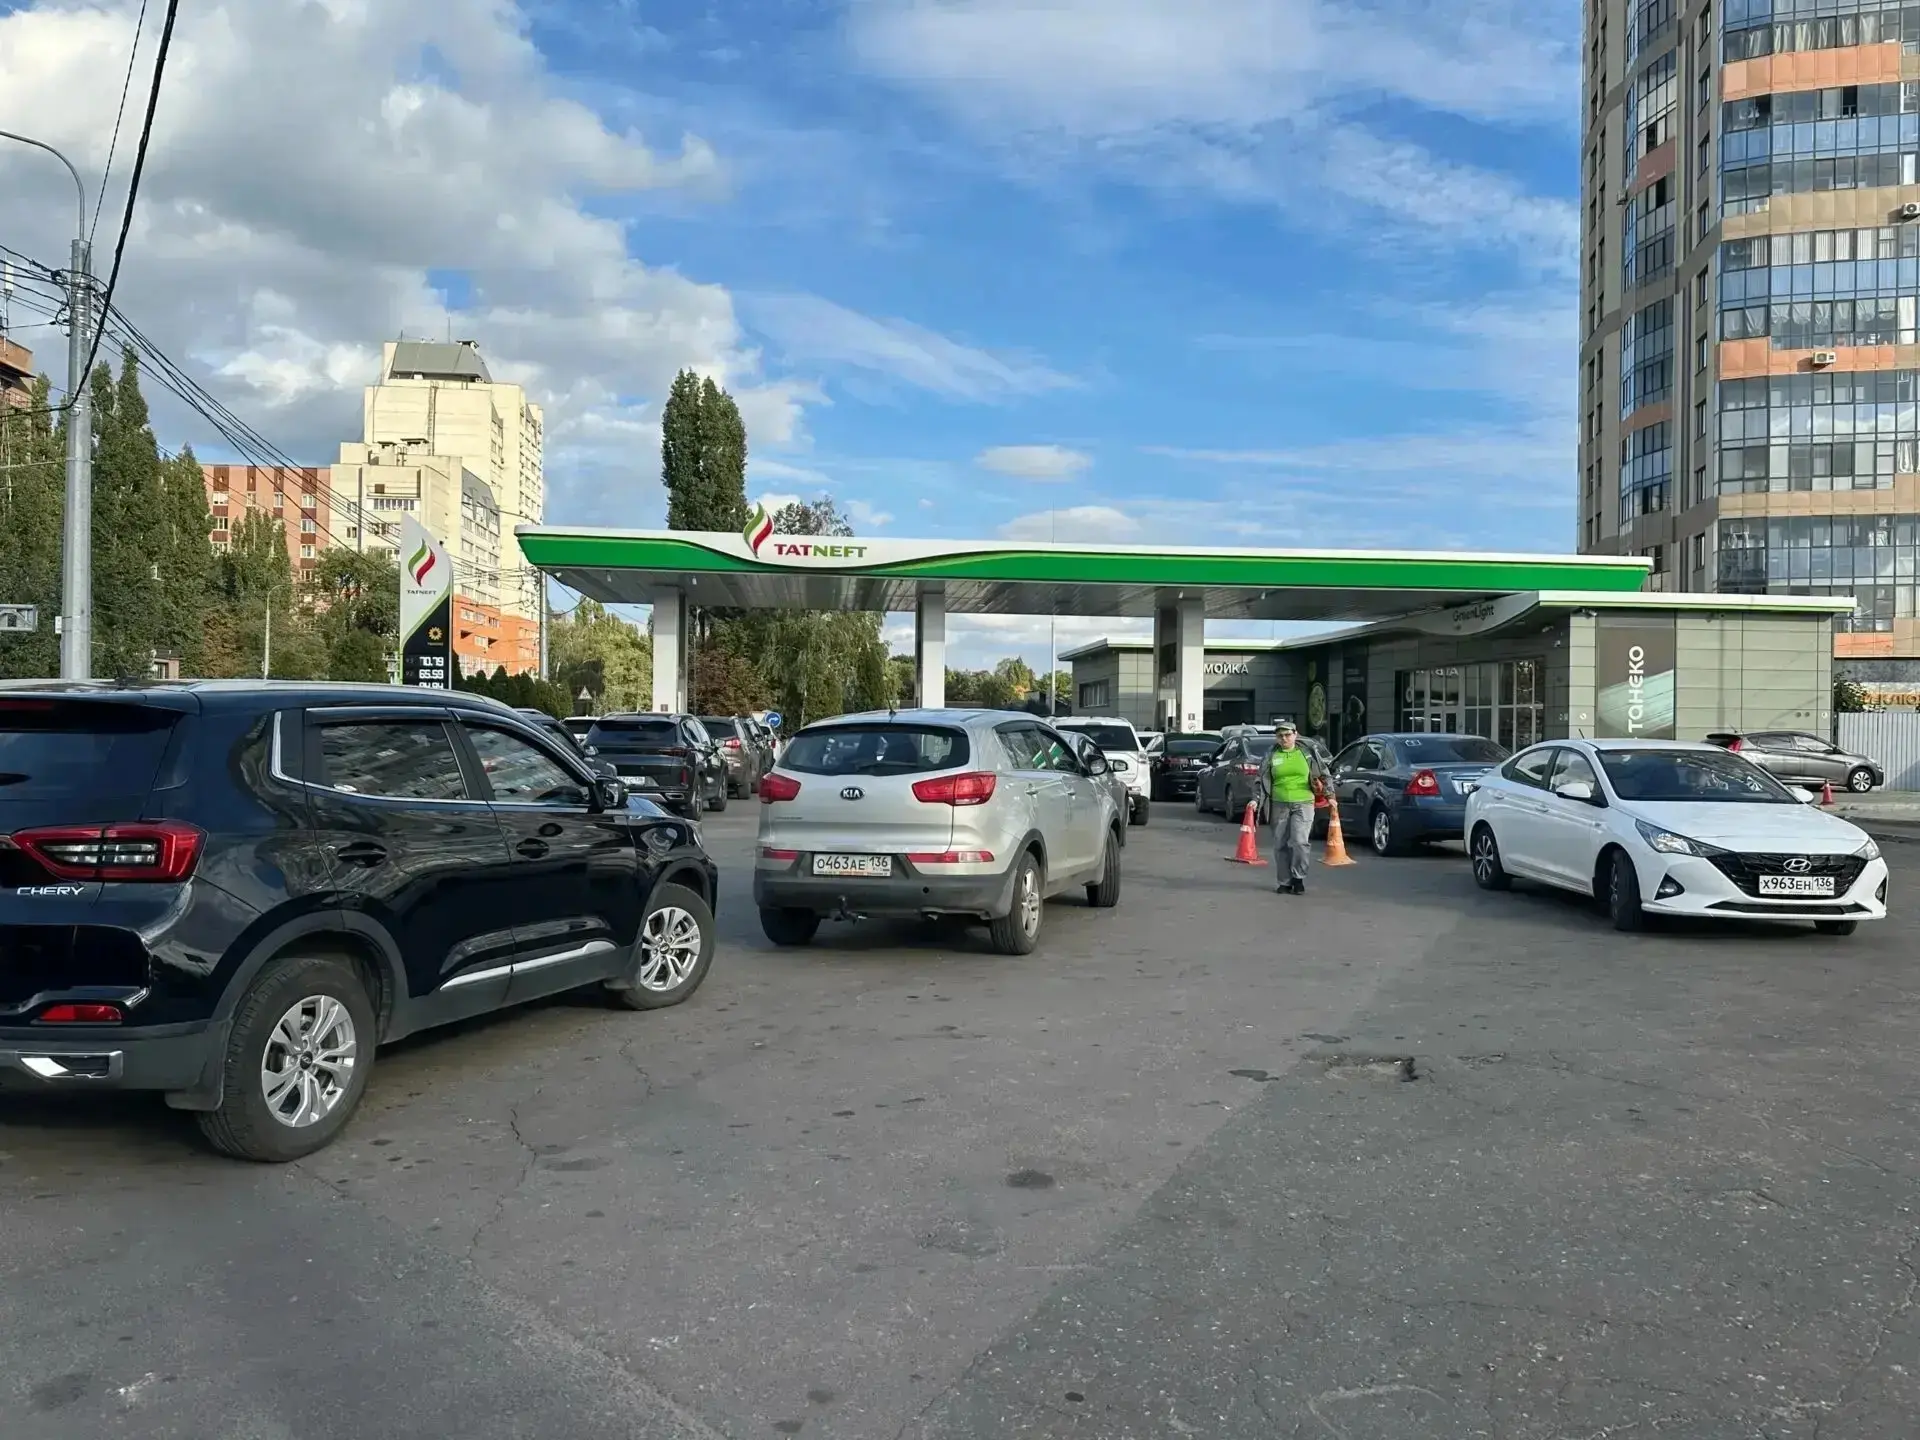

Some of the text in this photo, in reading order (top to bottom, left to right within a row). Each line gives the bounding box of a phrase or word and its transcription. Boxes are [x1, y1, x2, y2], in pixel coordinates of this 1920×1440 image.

[774, 544, 867, 558] TATNEFT
[419, 656, 444, 667] 70.79
[1204, 662, 1249, 674] МОЙКА
[843, 789, 861, 798] KIA
[817, 856, 888, 870] О463АЕ 136
[1763, 877, 1832, 890] Х963ЕН 136
[16, 886, 84, 896] CHERY
